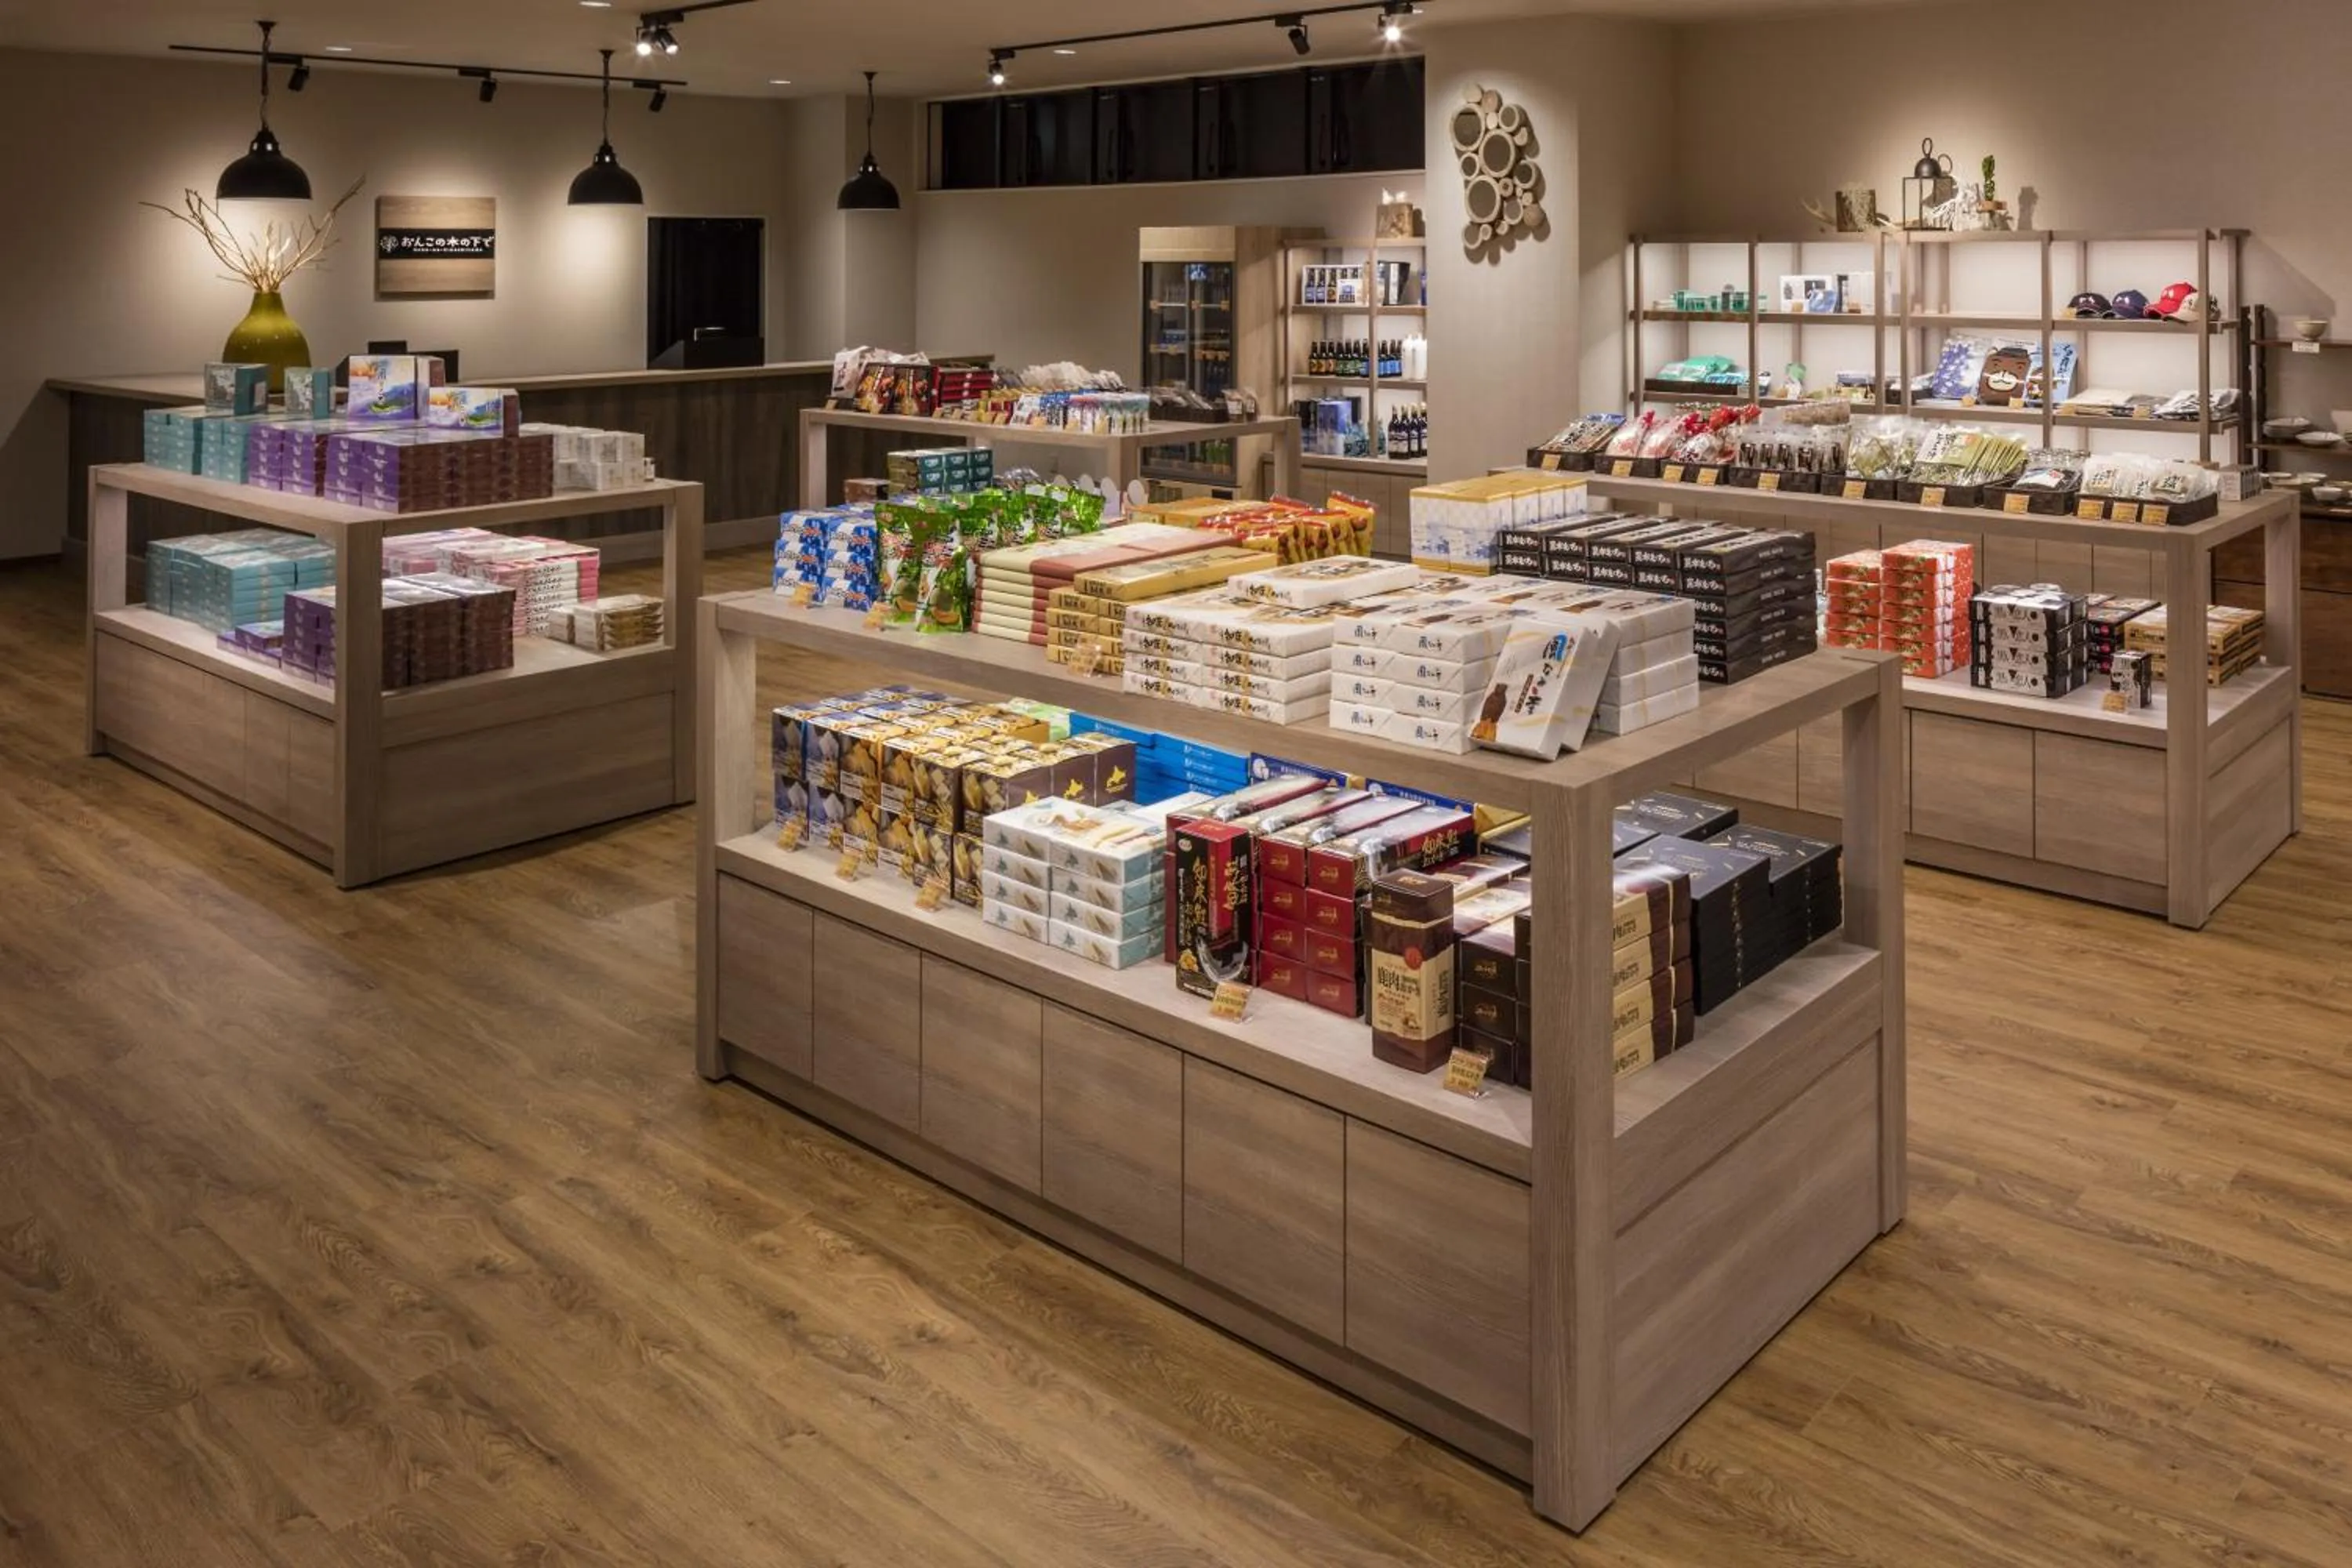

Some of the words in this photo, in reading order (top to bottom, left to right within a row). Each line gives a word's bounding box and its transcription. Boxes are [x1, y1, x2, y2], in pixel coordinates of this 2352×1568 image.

[401, 236, 495, 248] おんこの木の下で
